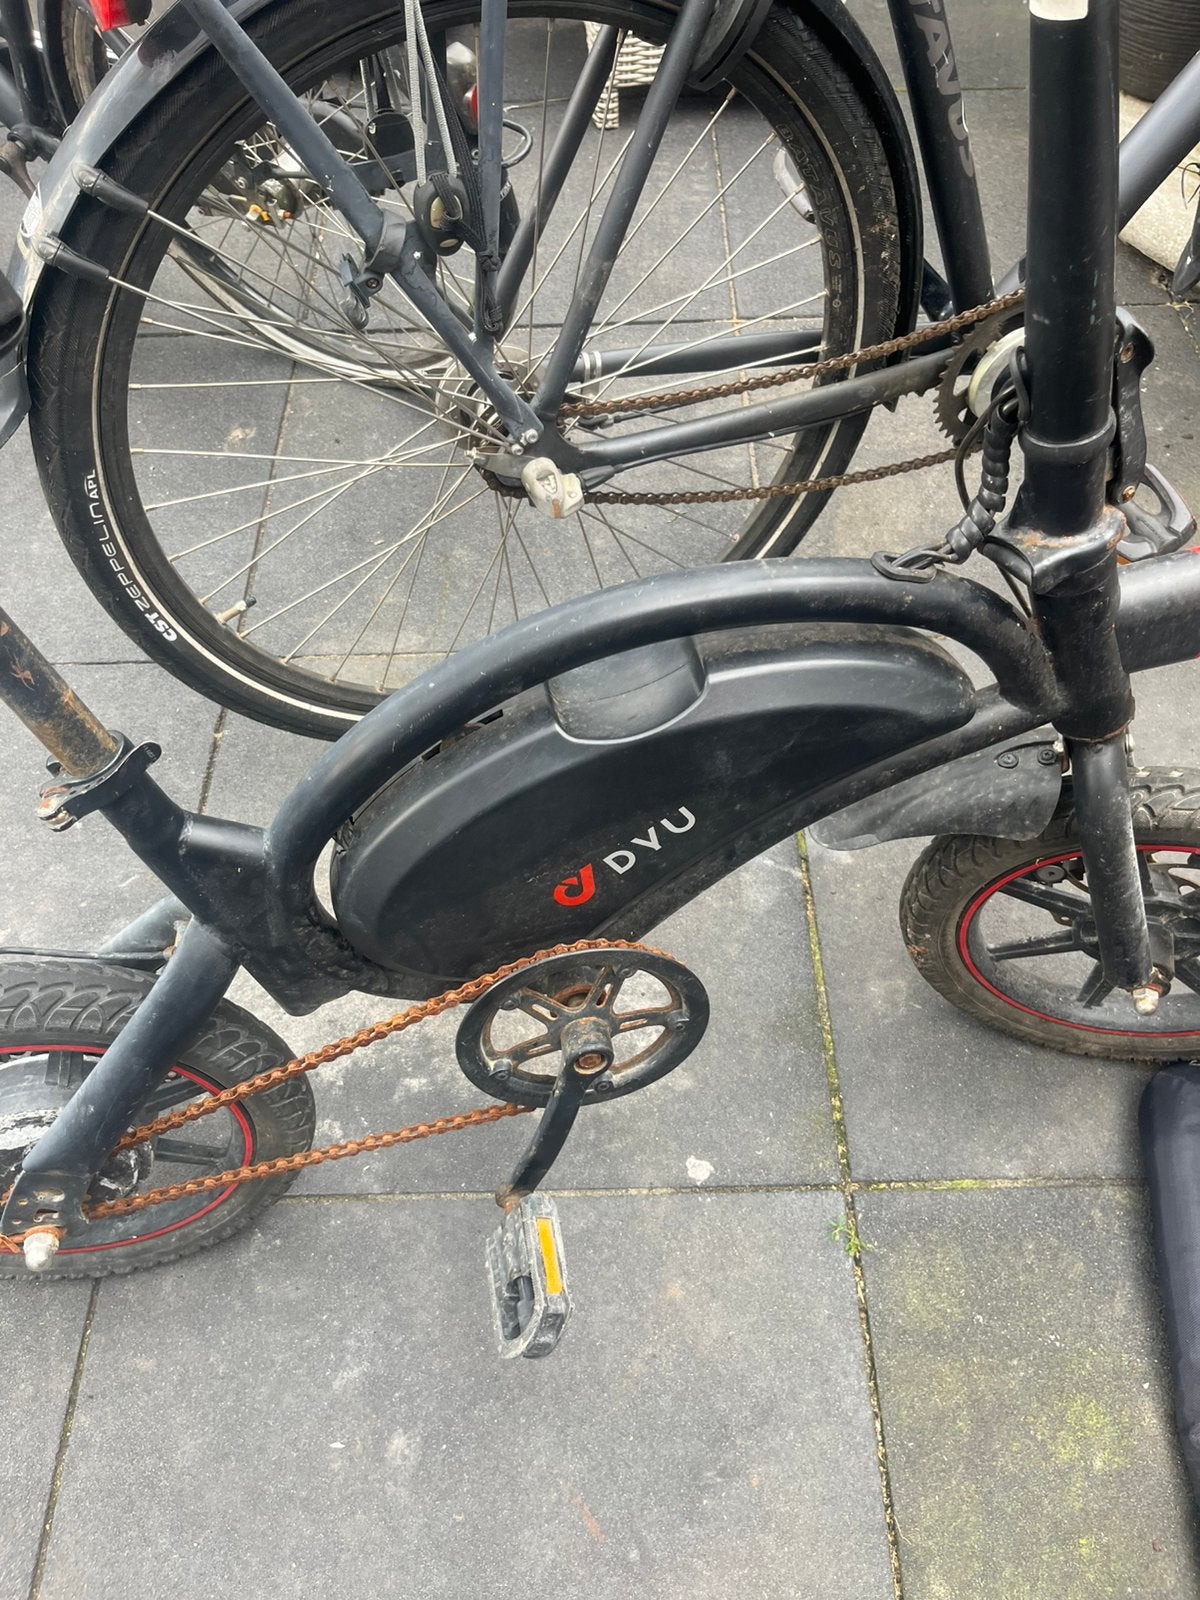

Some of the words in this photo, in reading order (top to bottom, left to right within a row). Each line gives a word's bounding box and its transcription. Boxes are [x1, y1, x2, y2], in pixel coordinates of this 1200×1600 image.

[776, 124, 841, 269] BATAVUS
[86, 469, 100, 499] APL
[89, 502, 151, 612] ZEPPELIN
[144, 612, 178, 642] CST
[602, 806, 696, 875] DYU
